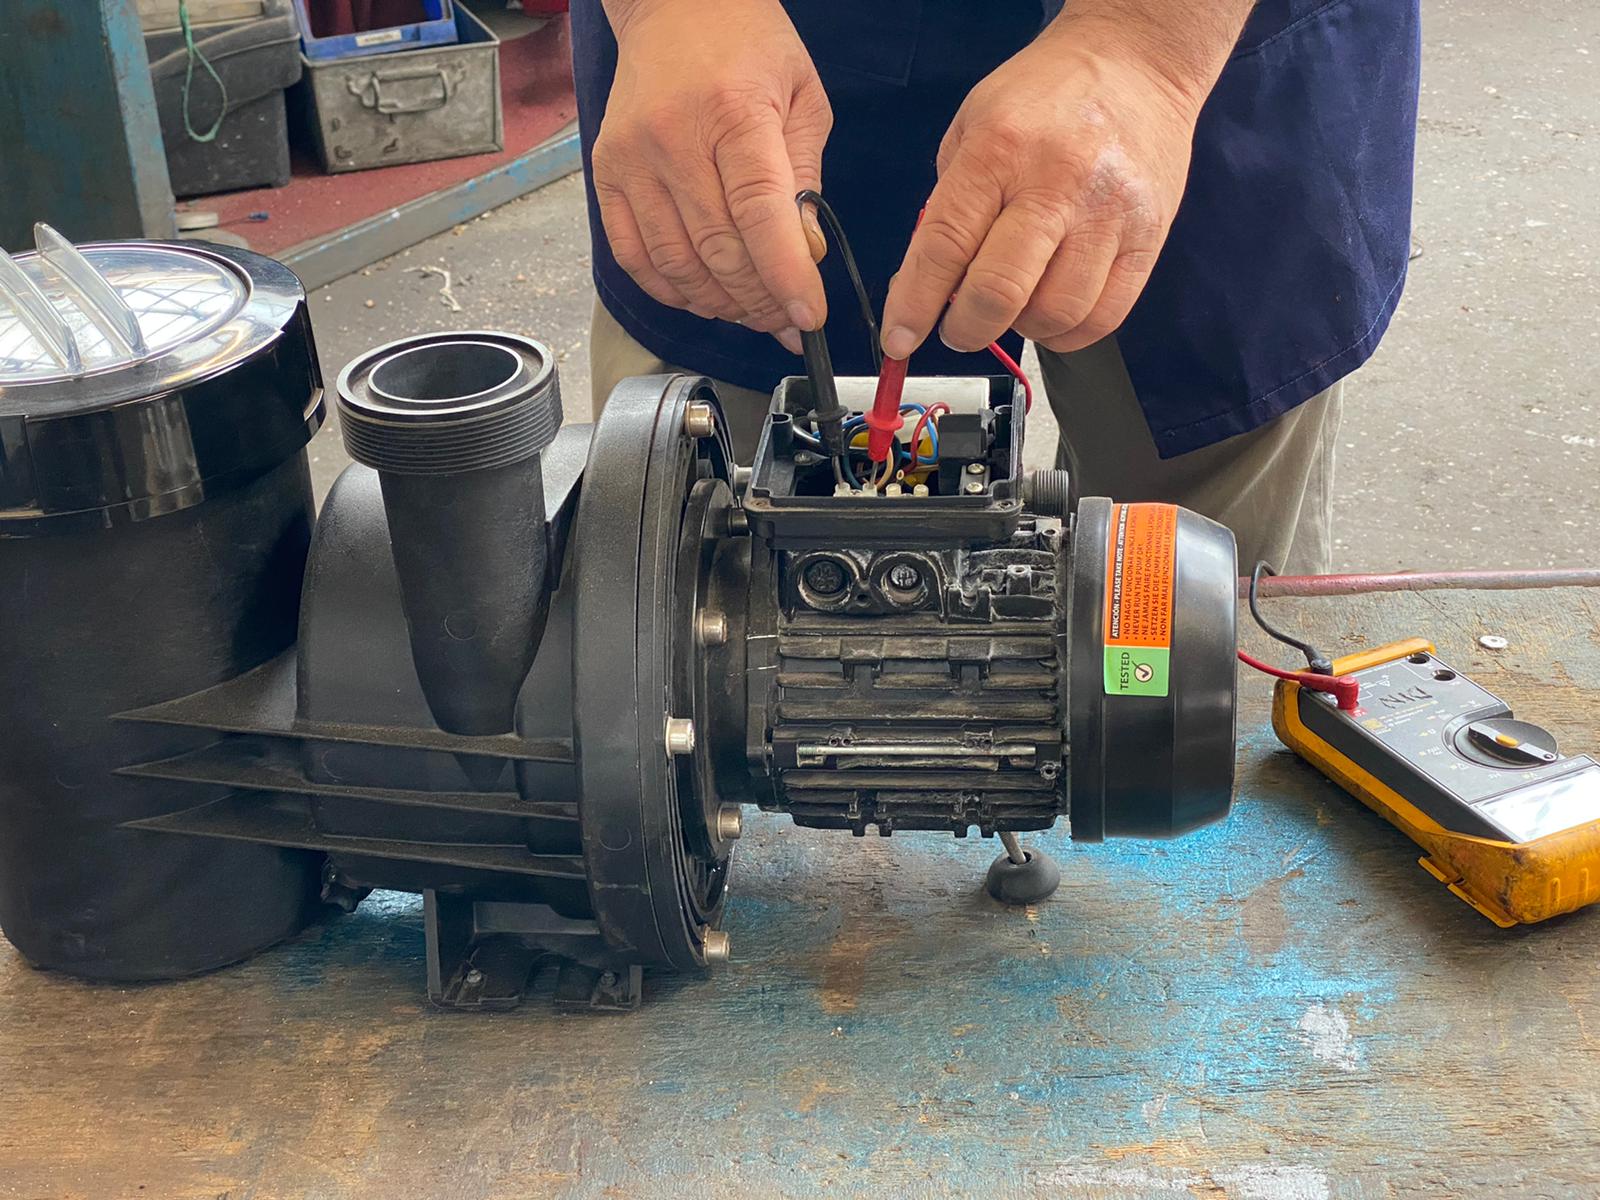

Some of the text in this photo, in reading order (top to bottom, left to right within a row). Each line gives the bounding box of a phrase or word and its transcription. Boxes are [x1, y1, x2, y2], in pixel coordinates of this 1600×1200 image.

[1145, 531, 1153, 572] FONCTIONNER
[1162, 544, 1170, 584] FUNZIONARE
[1126, 556, 1134, 596] FUNCIONAR
[1153, 556, 1161, 578] PUMPE
[1112, 604, 1120, 637] ATENCIÓN
[1132, 610, 1140, 634] NEVER
[1142, 595, 1150, 622] JAMAIS
[1150, 607, 1158, 635] SETZEN
[1124, 623, 1130, 634] NO
[1142, 625, 1148, 635] NE
[1120, 652, 1130, 690] TESTED
